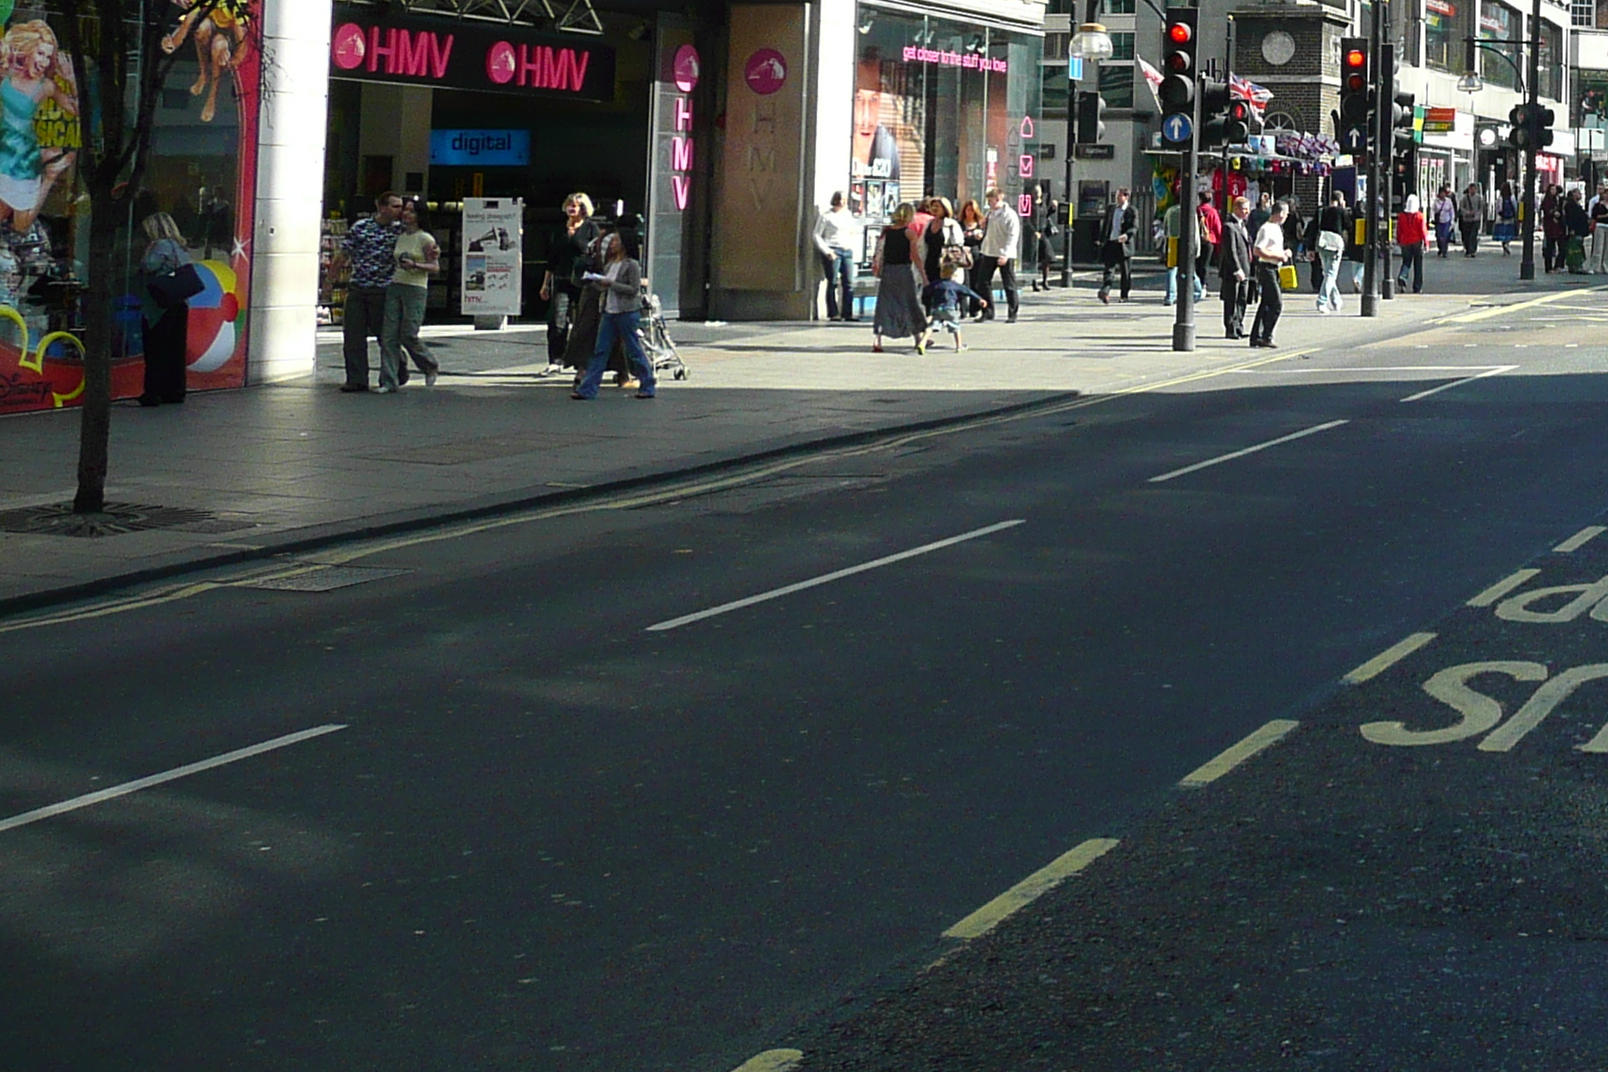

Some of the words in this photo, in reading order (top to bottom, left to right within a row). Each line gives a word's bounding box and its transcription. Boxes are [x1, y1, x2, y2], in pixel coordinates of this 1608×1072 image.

[366, 26, 454, 78] HMV
[516, 44, 590, 93] HMV
[34, 120, 82, 147] SICAL
[452, 132, 511, 155] digital
[672, 97, 694, 211] HMV
[750, 102, 777, 211] HMV
